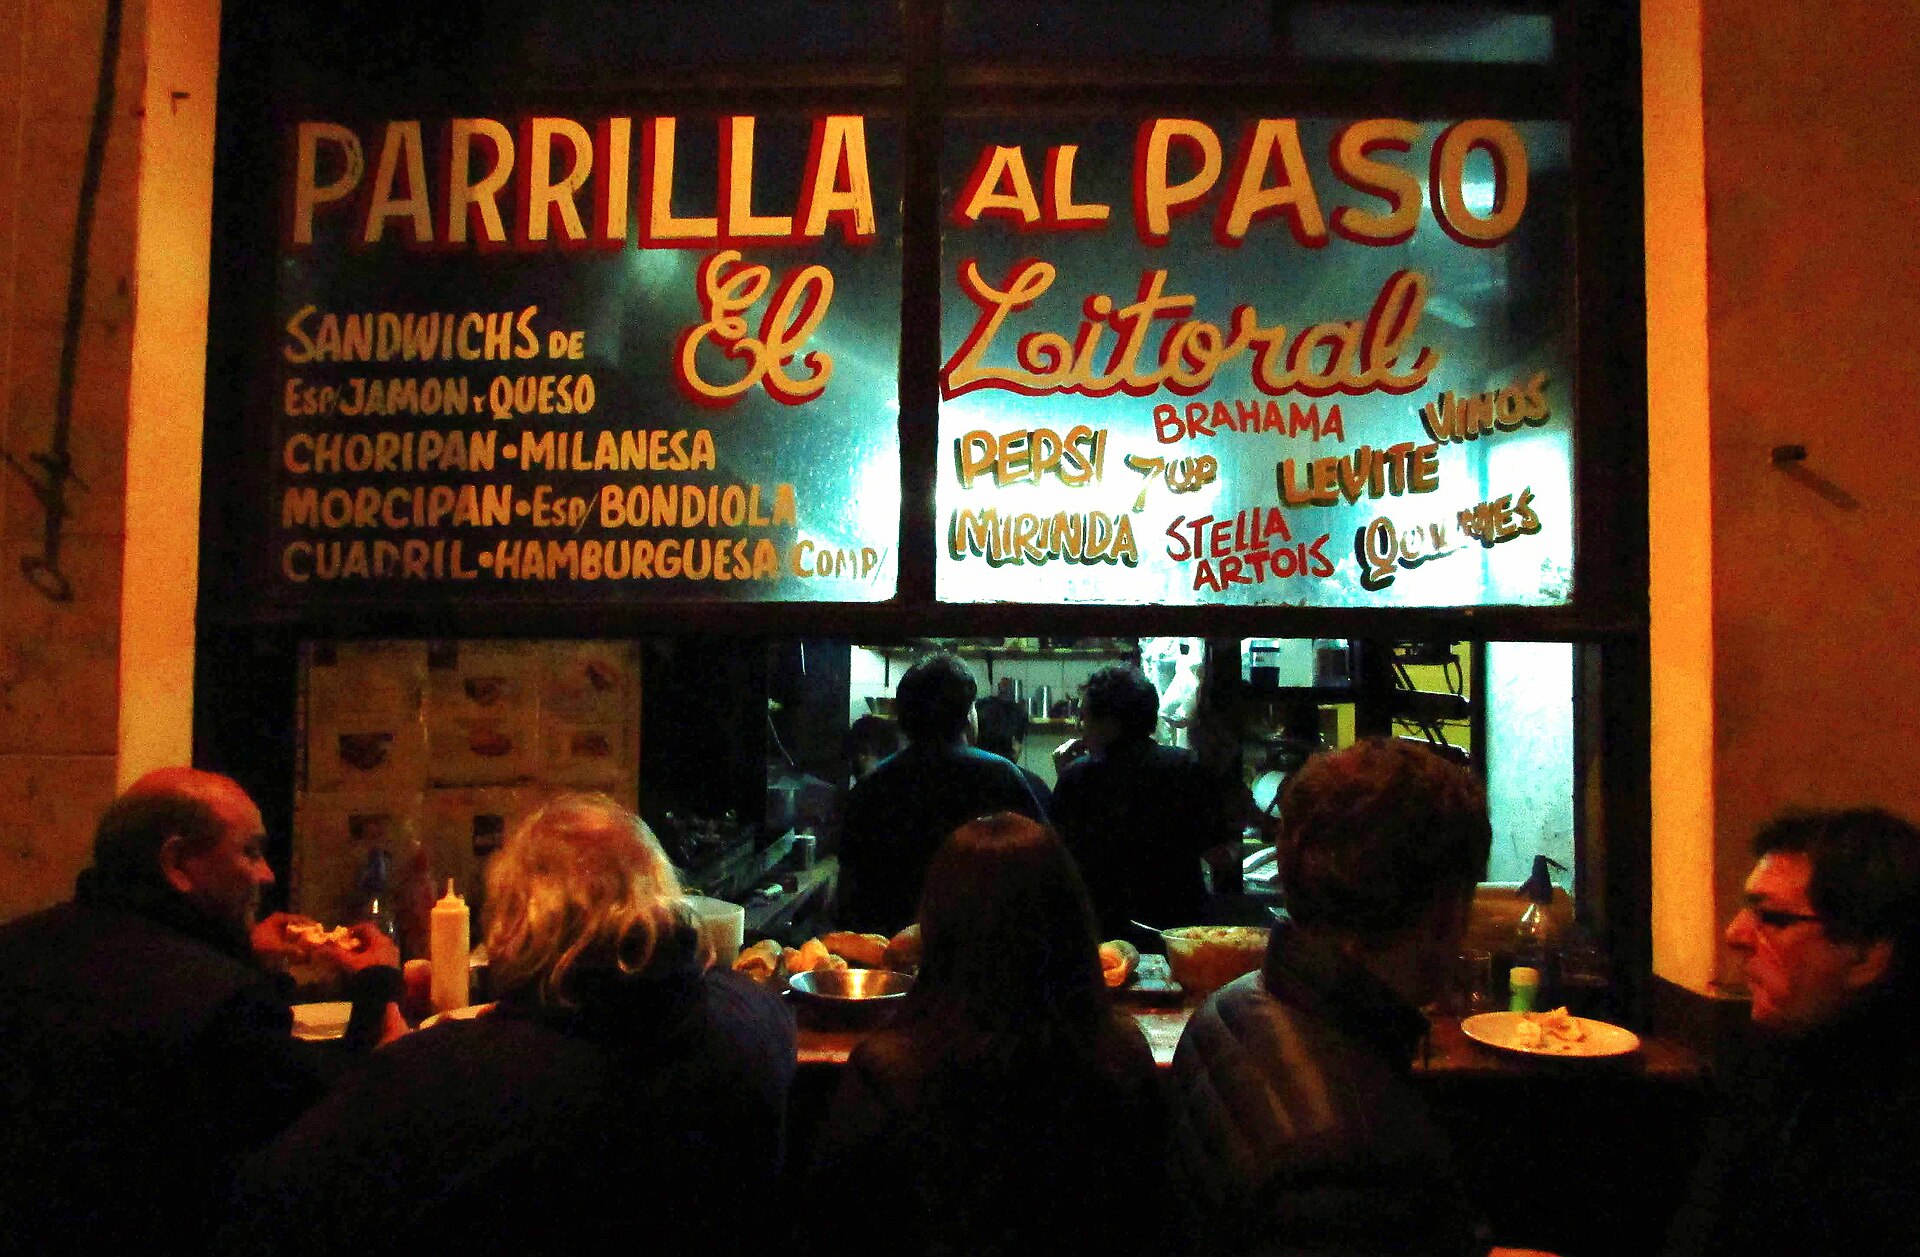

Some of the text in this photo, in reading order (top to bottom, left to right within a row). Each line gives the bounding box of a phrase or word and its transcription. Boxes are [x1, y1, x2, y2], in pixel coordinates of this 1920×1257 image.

[290, 114, 1533, 250] PARRILLA AL PASO
[284, 304, 586, 364] SANDWICHS DE
[677, 249, 1440, 403] El Litoral
[338, 376, 469, 416] JAMON
[490, 373, 597, 420] QUESO
[1153, 400, 1345, 444] BRAHAMA
[1418, 375, 1551, 445] VINOS
[283, 429, 717, 474] CHORIPAN MILANESA
[953, 424, 1109, 490] PEPSI
[1276, 441, 1440, 508] LEVITE
[282, 484, 513, 530] MORCIPAN
[600, 483, 798, 529] BONDIOLA
[1166, 506, 1291, 563] STELLA
[282, 540, 478, 583] CUADRIL
[494, 538, 780, 582] HAMBURGUESA
[947, 505, 1140, 569] MIRINDA
[1192, 532, 1334, 593] ARTOIS
